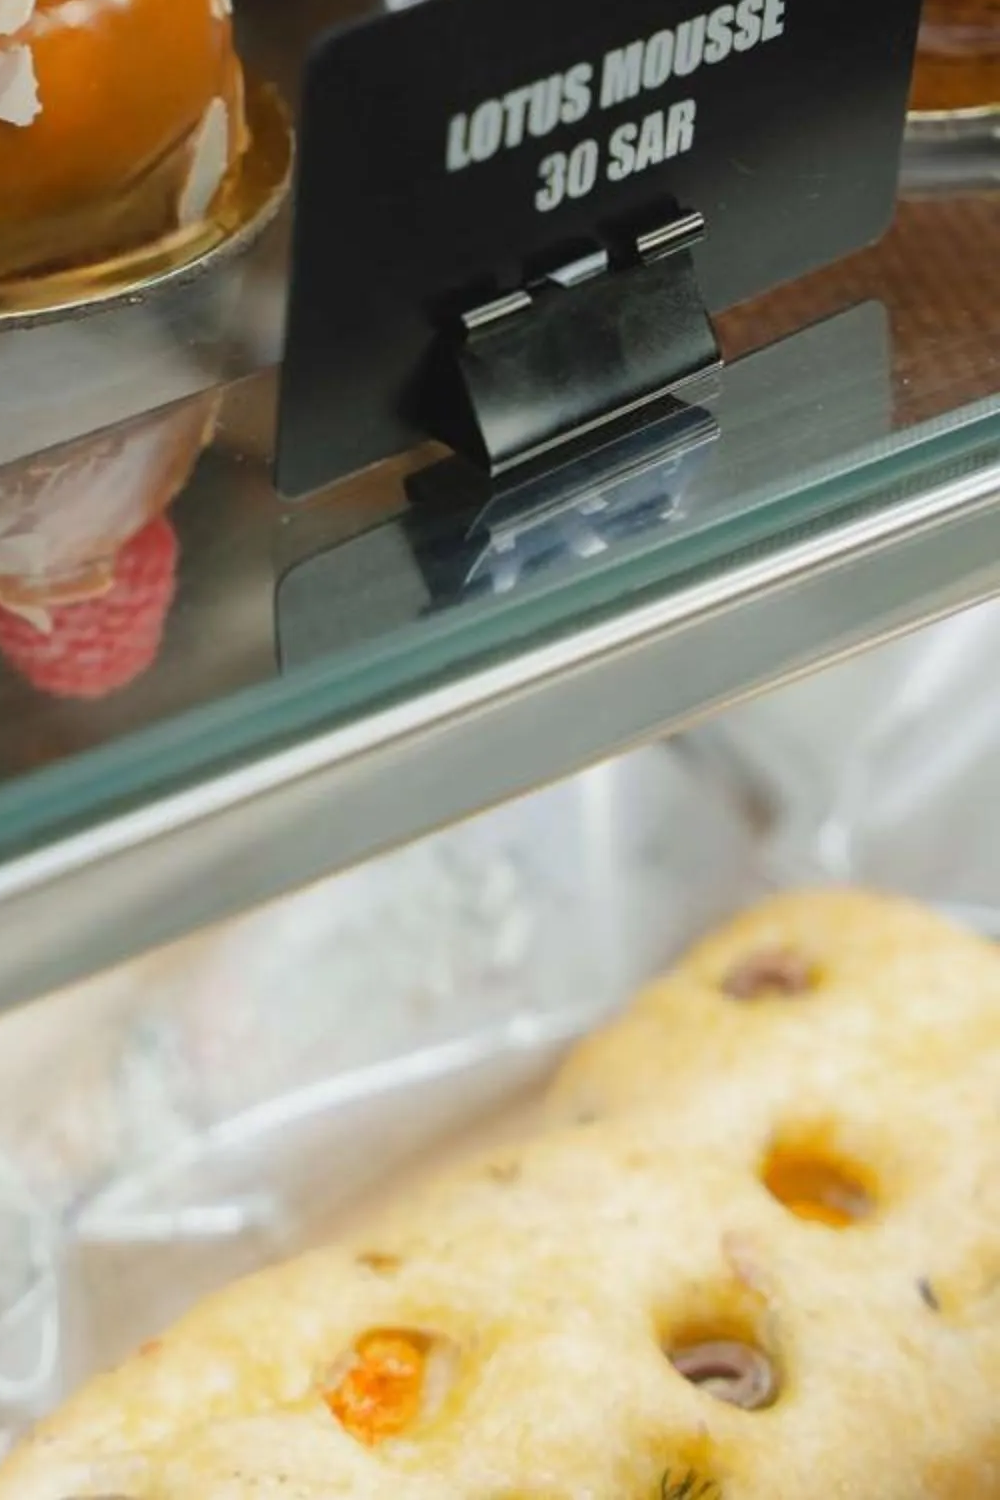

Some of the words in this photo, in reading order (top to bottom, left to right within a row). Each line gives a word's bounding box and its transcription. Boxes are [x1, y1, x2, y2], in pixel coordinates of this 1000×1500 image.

[446, 62, 593, 172] LOTUS
[535, 138, 598, 212] 30
[606, 99, 696, 181] SAR
